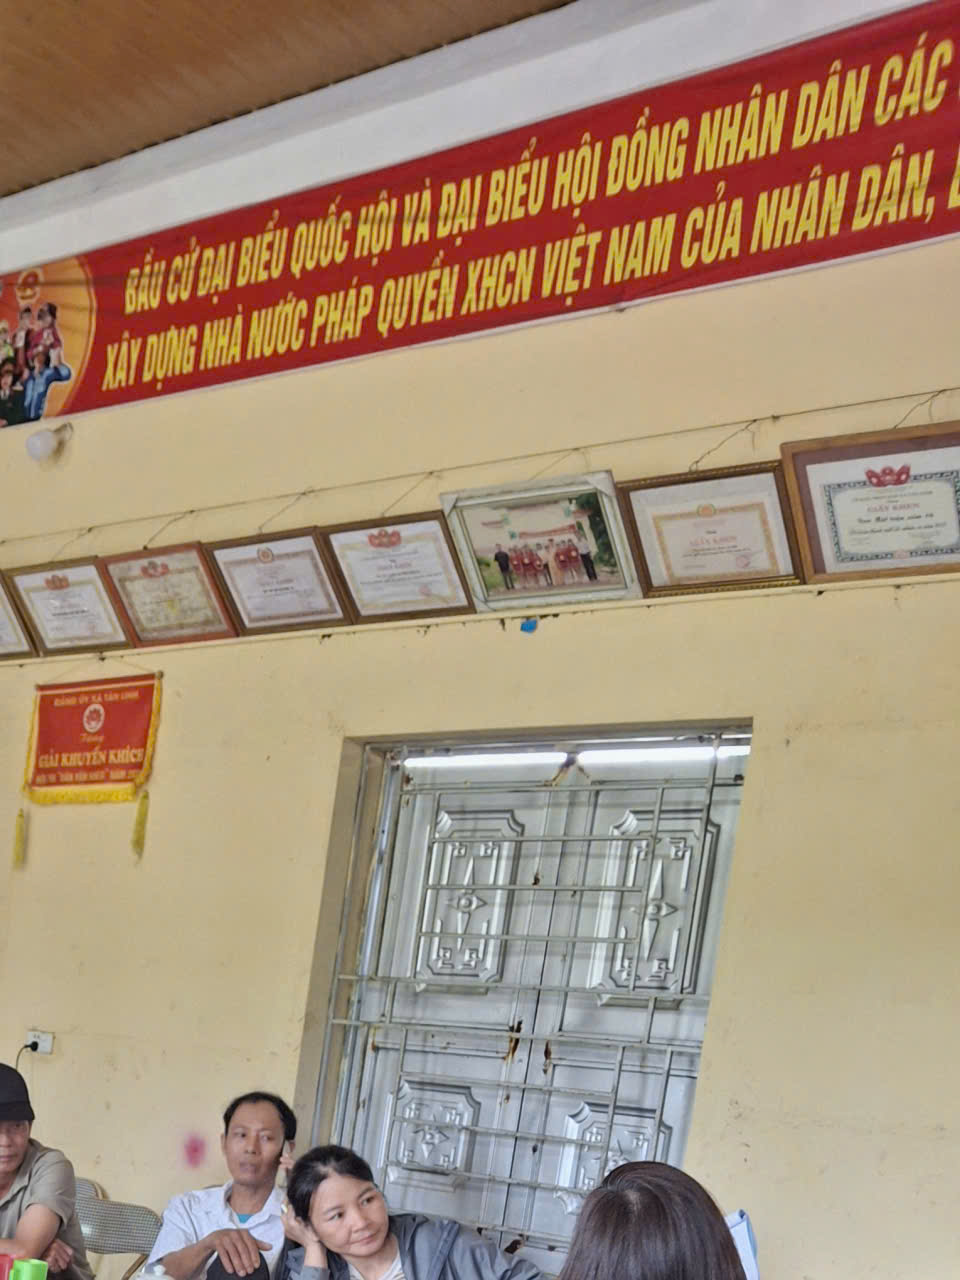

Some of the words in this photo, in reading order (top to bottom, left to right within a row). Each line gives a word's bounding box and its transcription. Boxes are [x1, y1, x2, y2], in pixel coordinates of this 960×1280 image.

[101, 330, 142, 392] XÂY
[142, 324, 199, 391] DỰNG
[199, 303, 244, 371] NHÀ
[246, 291, 308, 361] NƯỚC
[309, 275, 375, 348] PHÁP
[377, 249, 460, 339] QUYỀN
[460, 246, 538, 316] XHCN
[541, 222, 603, 307] VIỆT
[603, 212, 677, 286] NAM
[680, 180, 744, 269] CỦA
[750, 163, 850, 255] NHÂN
[851, 142, 936, 233] DÂN,
[166, 235, 201, 305] CỬ
[197, 241, 236, 305] ĐẠI
[236, 208, 289, 288] BIỂU
[290, 194, 353, 280] QUỐC
[353, 189, 398, 267] HỘI
[401, 177, 432, 248] VÀ
[436, 175, 483, 247] ĐẠI
[484, 136, 550, 228] BIỂU
[551, 131, 603, 218] HỘI
[605, 106, 690, 197] ĐỒNG
[692, 82, 789, 175] NHÂN
[791, 59, 872, 150] DÂN
[874, 31, 954, 127] CÁC
[60, 743, 108, 768] KHUYẾN
[108, 743, 145, 765] KHÍCH
